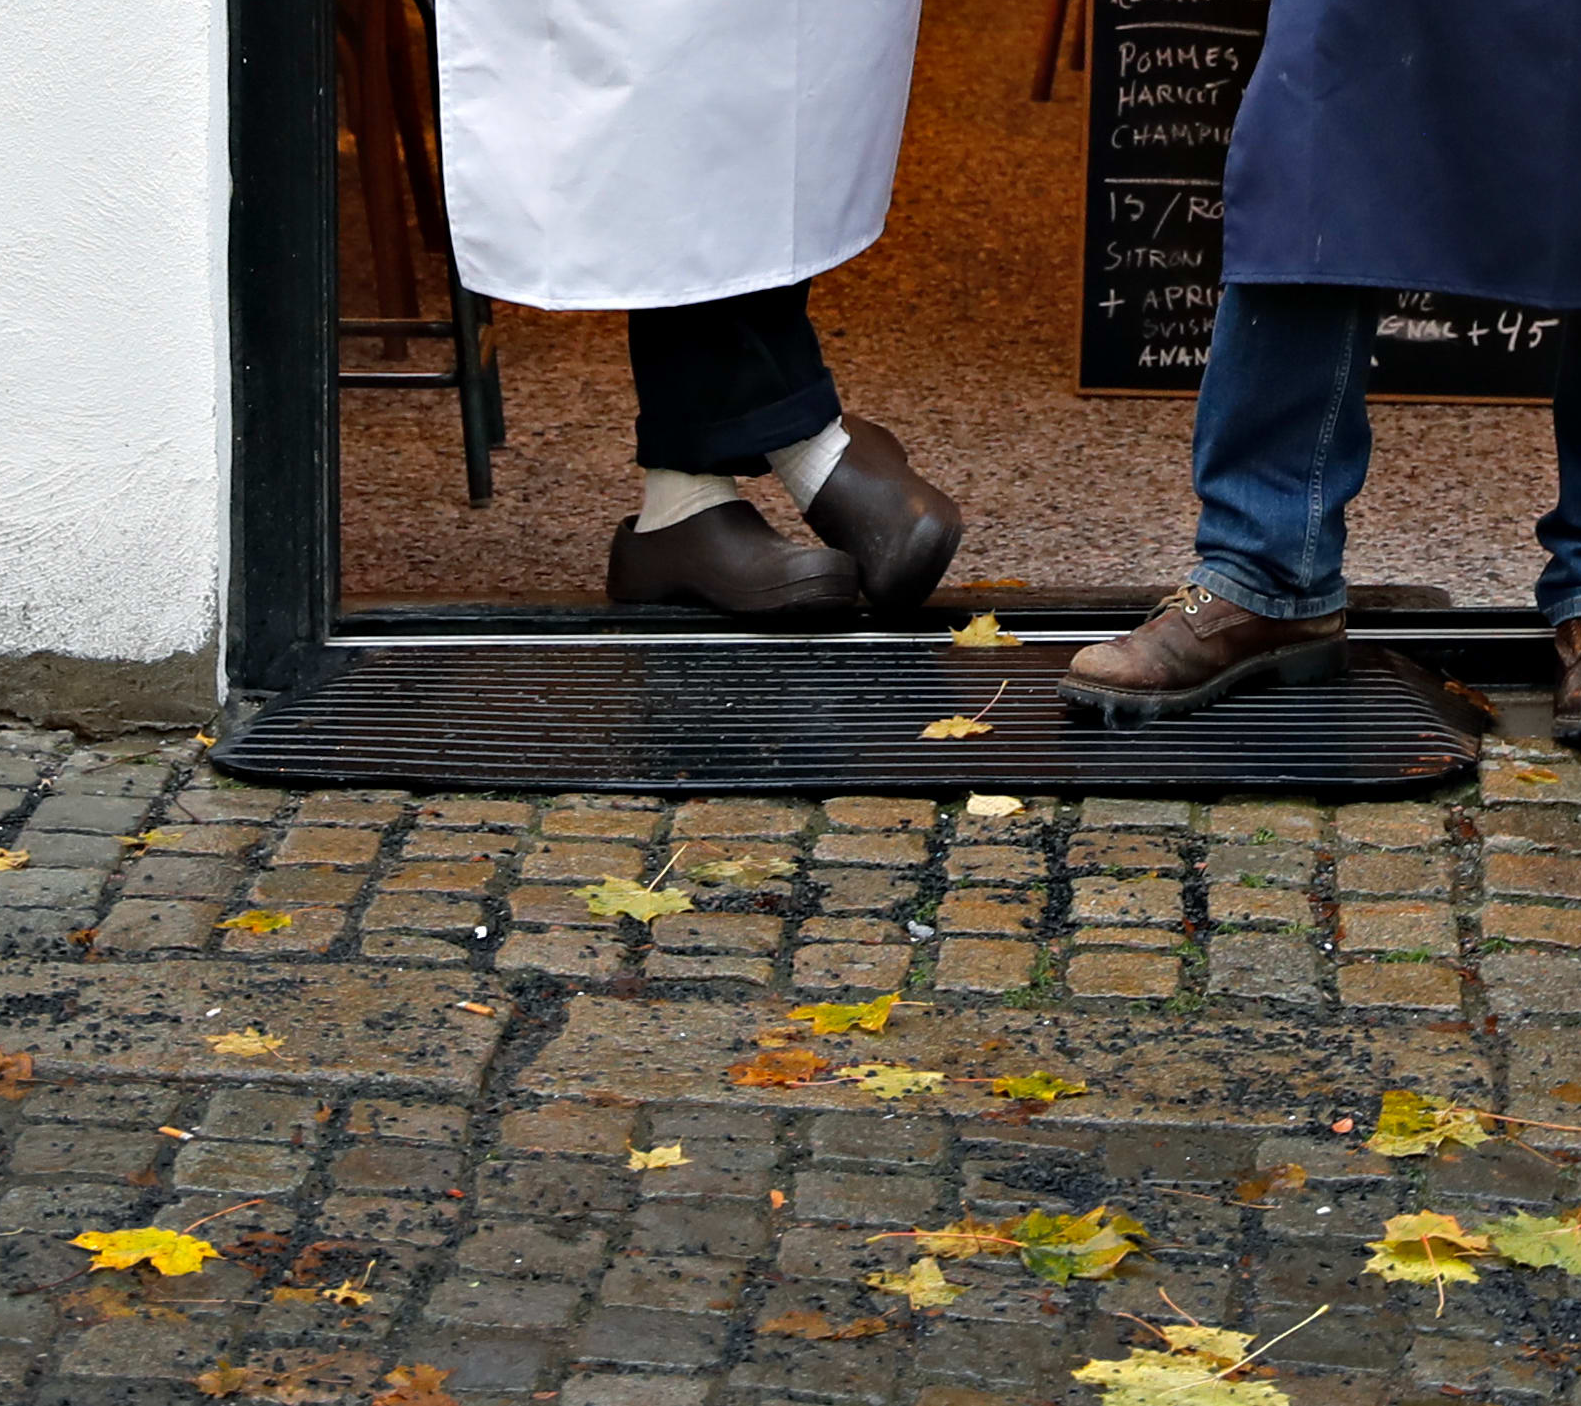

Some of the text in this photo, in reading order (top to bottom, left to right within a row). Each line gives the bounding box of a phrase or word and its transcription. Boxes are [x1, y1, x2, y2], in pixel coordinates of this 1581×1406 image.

[1118, 41, 1239, 78] POMMES
[1117, 72, 1228, 116] HARICOT
[1104, 241, 1203, 271] SITRON
